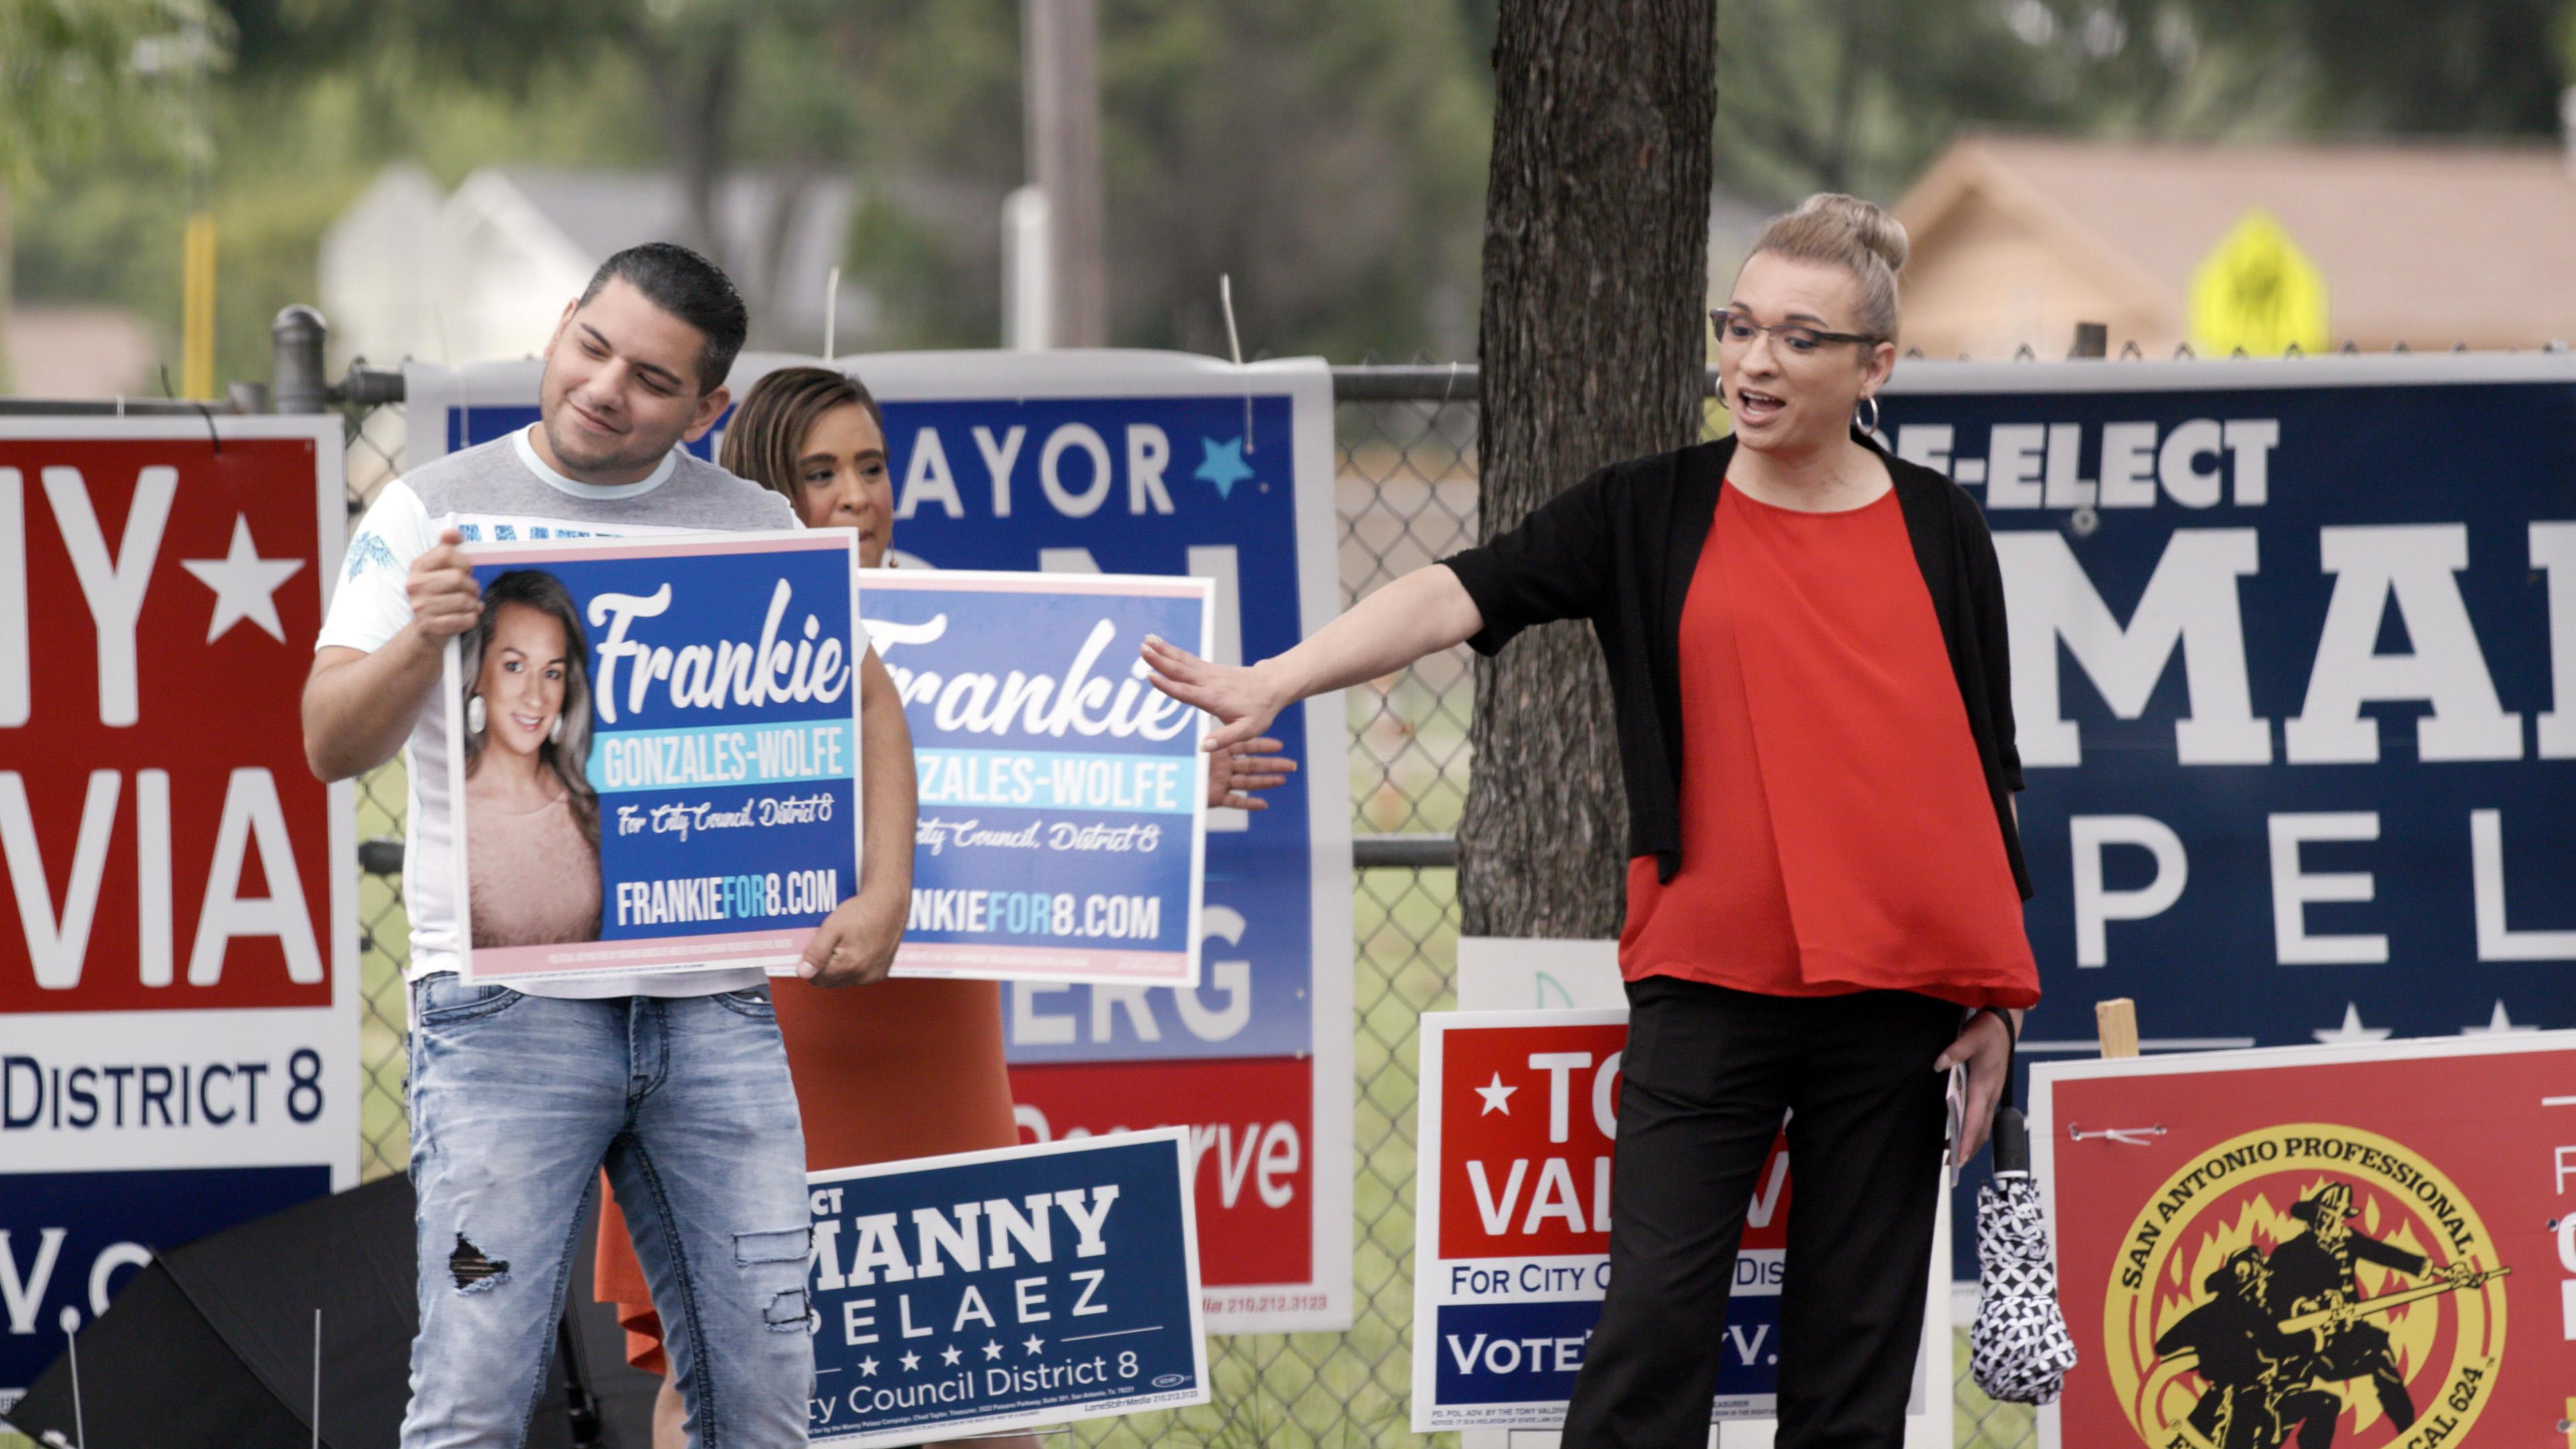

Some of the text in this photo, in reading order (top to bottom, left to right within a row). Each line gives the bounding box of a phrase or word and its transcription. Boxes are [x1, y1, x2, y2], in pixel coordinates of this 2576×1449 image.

[1865, 419, 2279, 510] -ELECT
[0, 464, 179, 727] Y
[587, 578, 851, 724] Frankie
[605, 727, 844, 788] GONZALES-WOLFE
[617, 804, 646, 836] For
[650, 802, 692, 843] City
[759, 794, 820, 826] District
[818, 793, 834, 822] 8
[1049, 822, 1136, 852] District
[1136, 823, 1161, 853] 8
[616, 869, 837, 926] FRANKIEFOR8.COM
[2070, 808, 2576, 968] PEL
[286, 1048, 324, 1124] 8
[2121, 1220, 2161, 1289] SAN
[2157, 1139, 2278, 1224] ANTONIO
[2284, 1137, 2474, 1256] PROFESSIONAL
[1227, 1294, 1328, 1313] 210.212.3123
[1451, 1266, 1510, 1295] FOR
[1519, 1263, 1586, 1293] CITY
[849, 1371, 975, 1414] Council
[987, 1350, 1108, 1396] District
[1117, 1350, 1139, 1379] 8
[2447, 1366, 2483, 1413] 624
